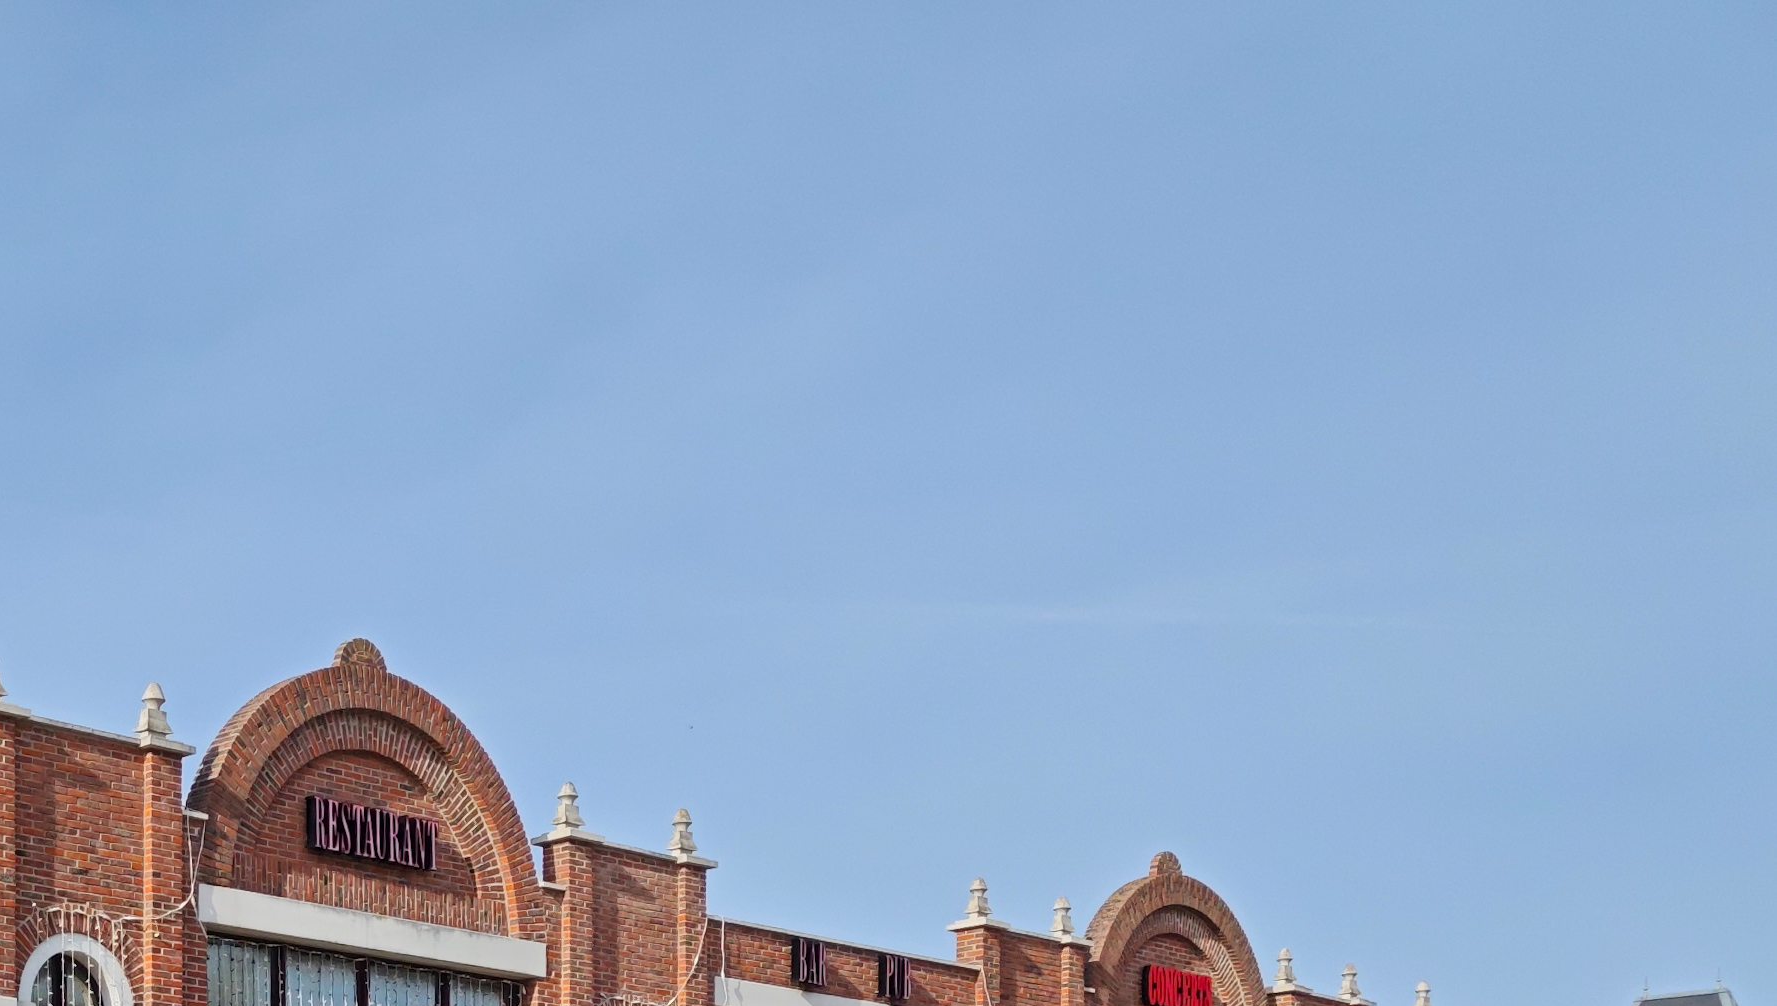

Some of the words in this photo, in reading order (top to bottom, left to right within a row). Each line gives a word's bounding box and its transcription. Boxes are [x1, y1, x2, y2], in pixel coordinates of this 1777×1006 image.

[314, 796, 439, 871] RESTAURANT
[799, 938, 827, 986] BAR
[885, 955, 912, 1000] PUB
